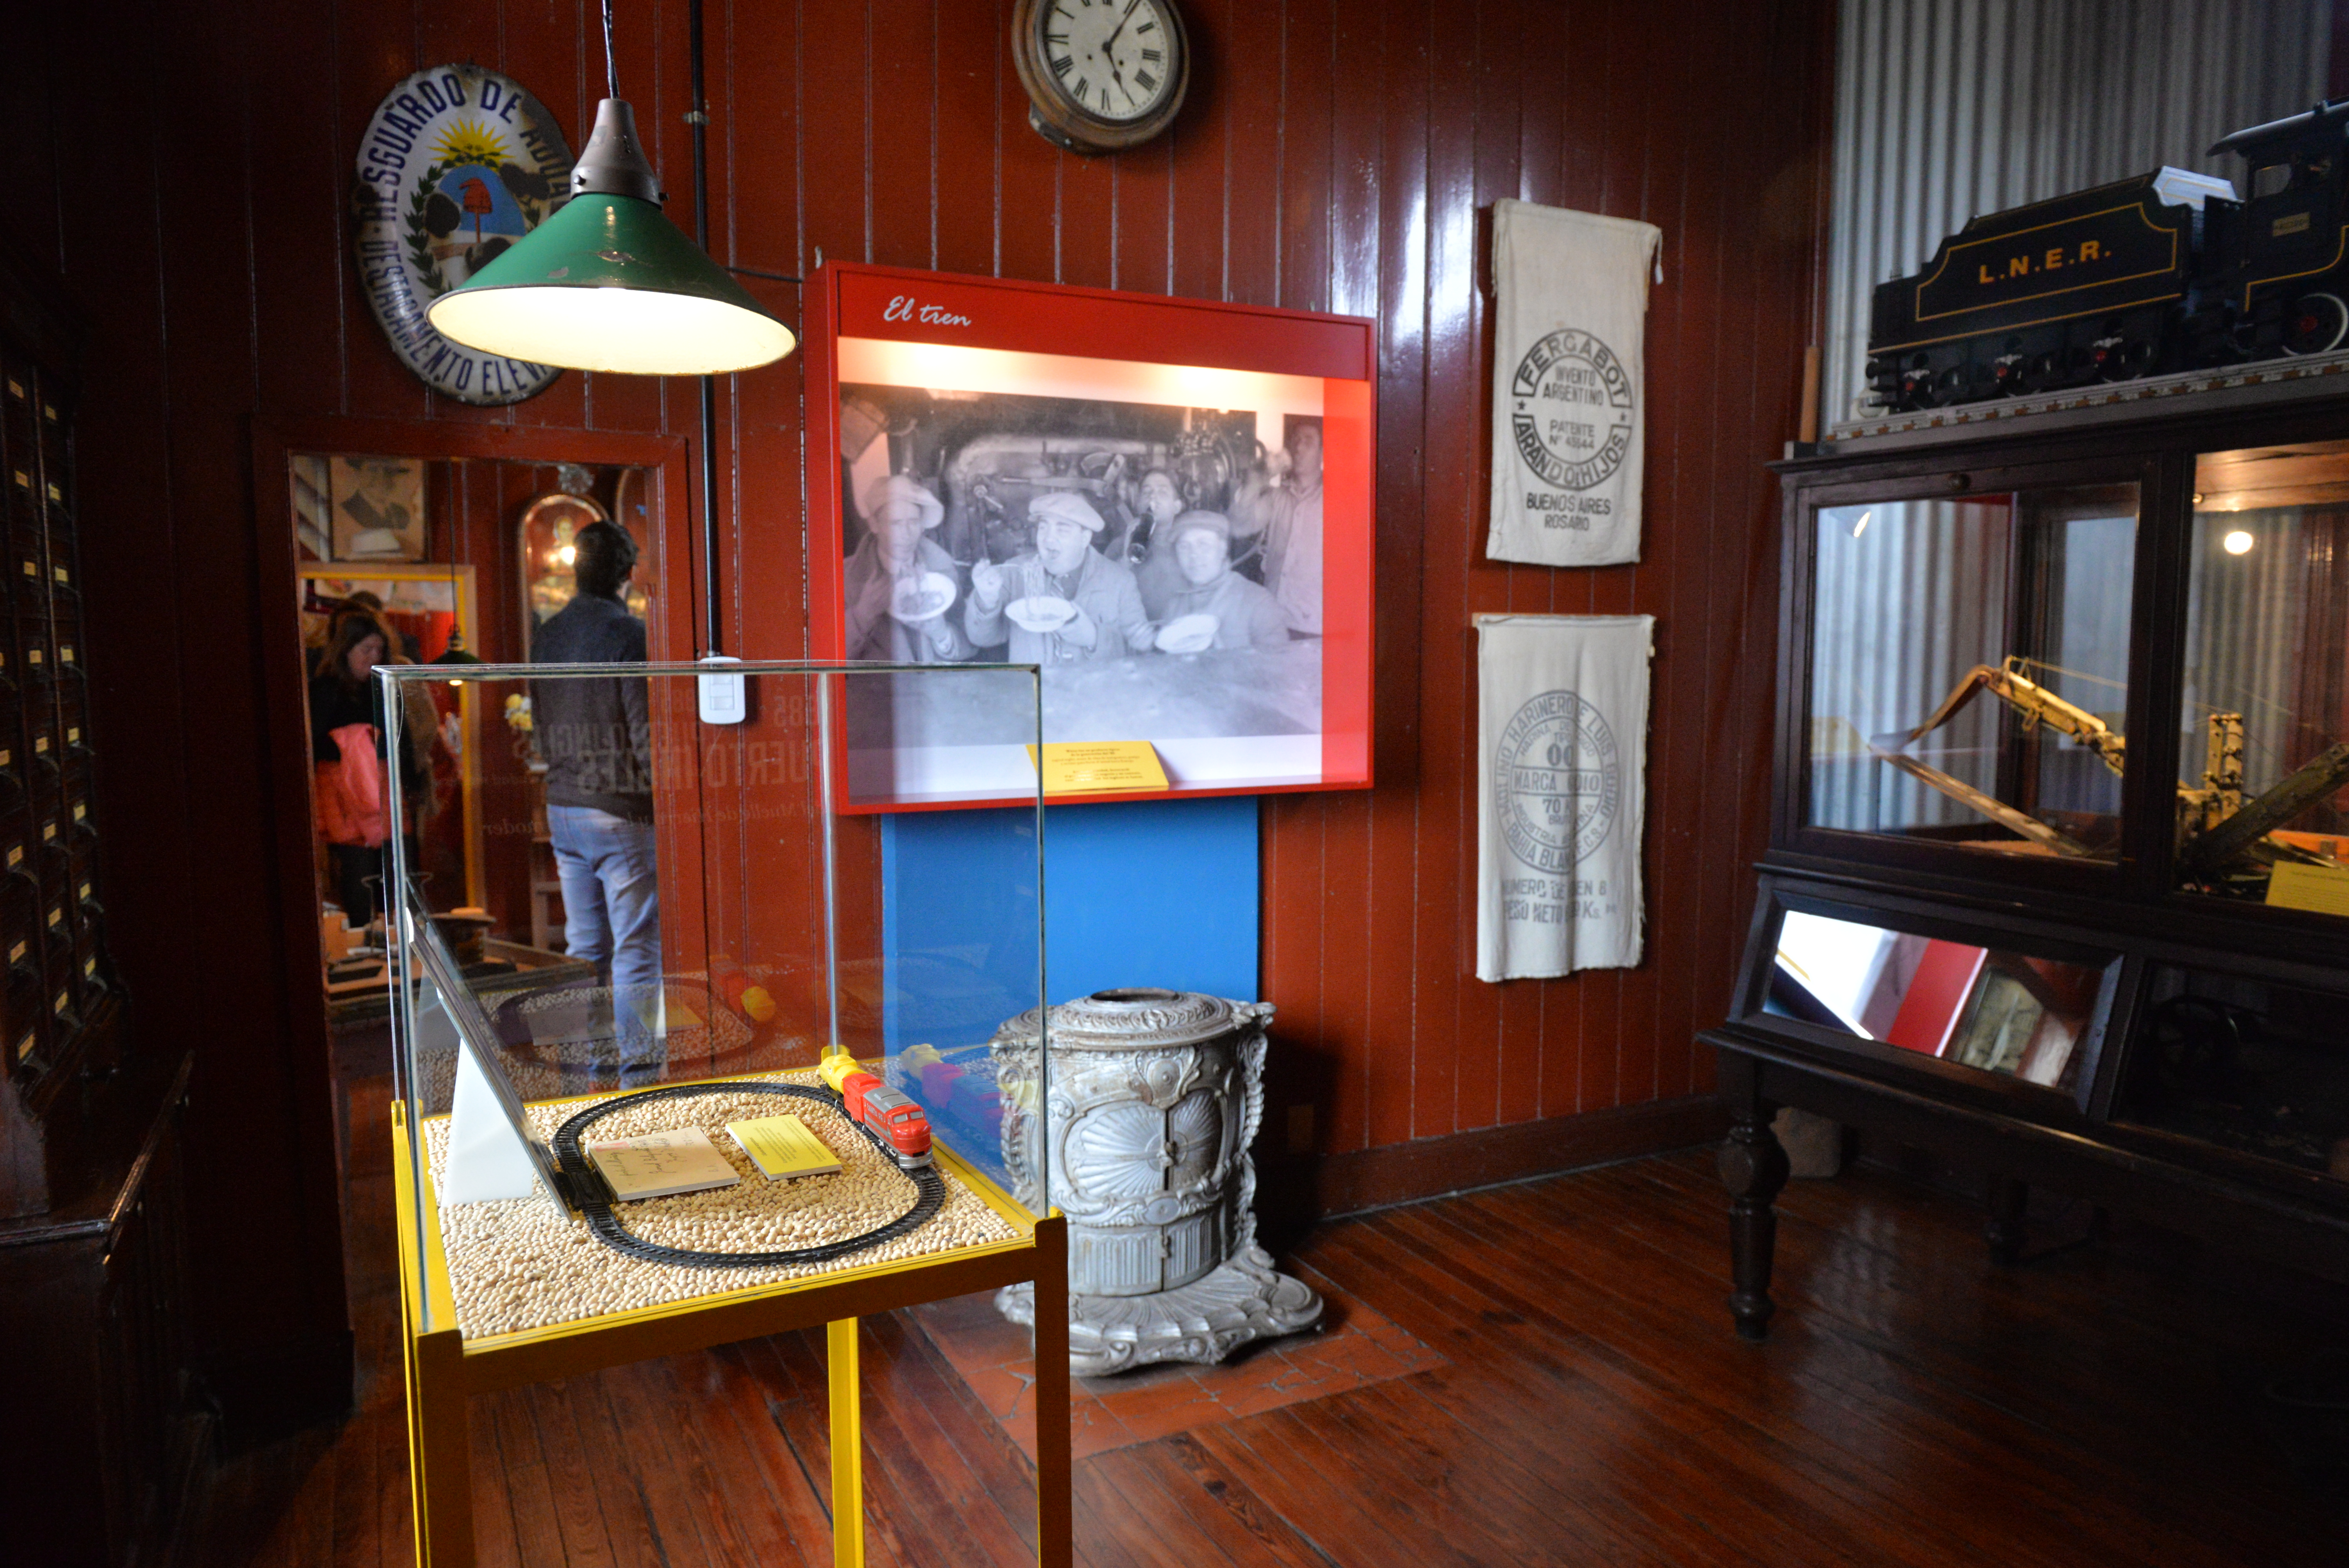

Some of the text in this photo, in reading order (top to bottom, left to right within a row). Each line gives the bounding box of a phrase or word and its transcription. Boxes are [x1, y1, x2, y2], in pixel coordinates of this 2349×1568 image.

[480, 78, 522, 124] DE
[519, 127, 571, 201] ADUA
[1979, 239, 2112, 285] L.N.E.R.
[360, 240, 547, 396] DESTACAMENTO ELEV
[883, 295, 972, 327] El tren
[1555, 365, 1596, 387] INVENTO
[1543, 382, 1604, 406] ARGENTINO
[1550, 419, 1595, 438] PATENTE
[1516, 423, 1575, 485] ARANDO
[1581, 433, 1625, 485] HIJOS
[1526, 492, 1611, 515] BUENOS AIRES
[1544, 514, 1590, 531] ROSARIO
[1513, 770, 1557, 791] MARCA
[1542, 798, 1561, 814] 70
